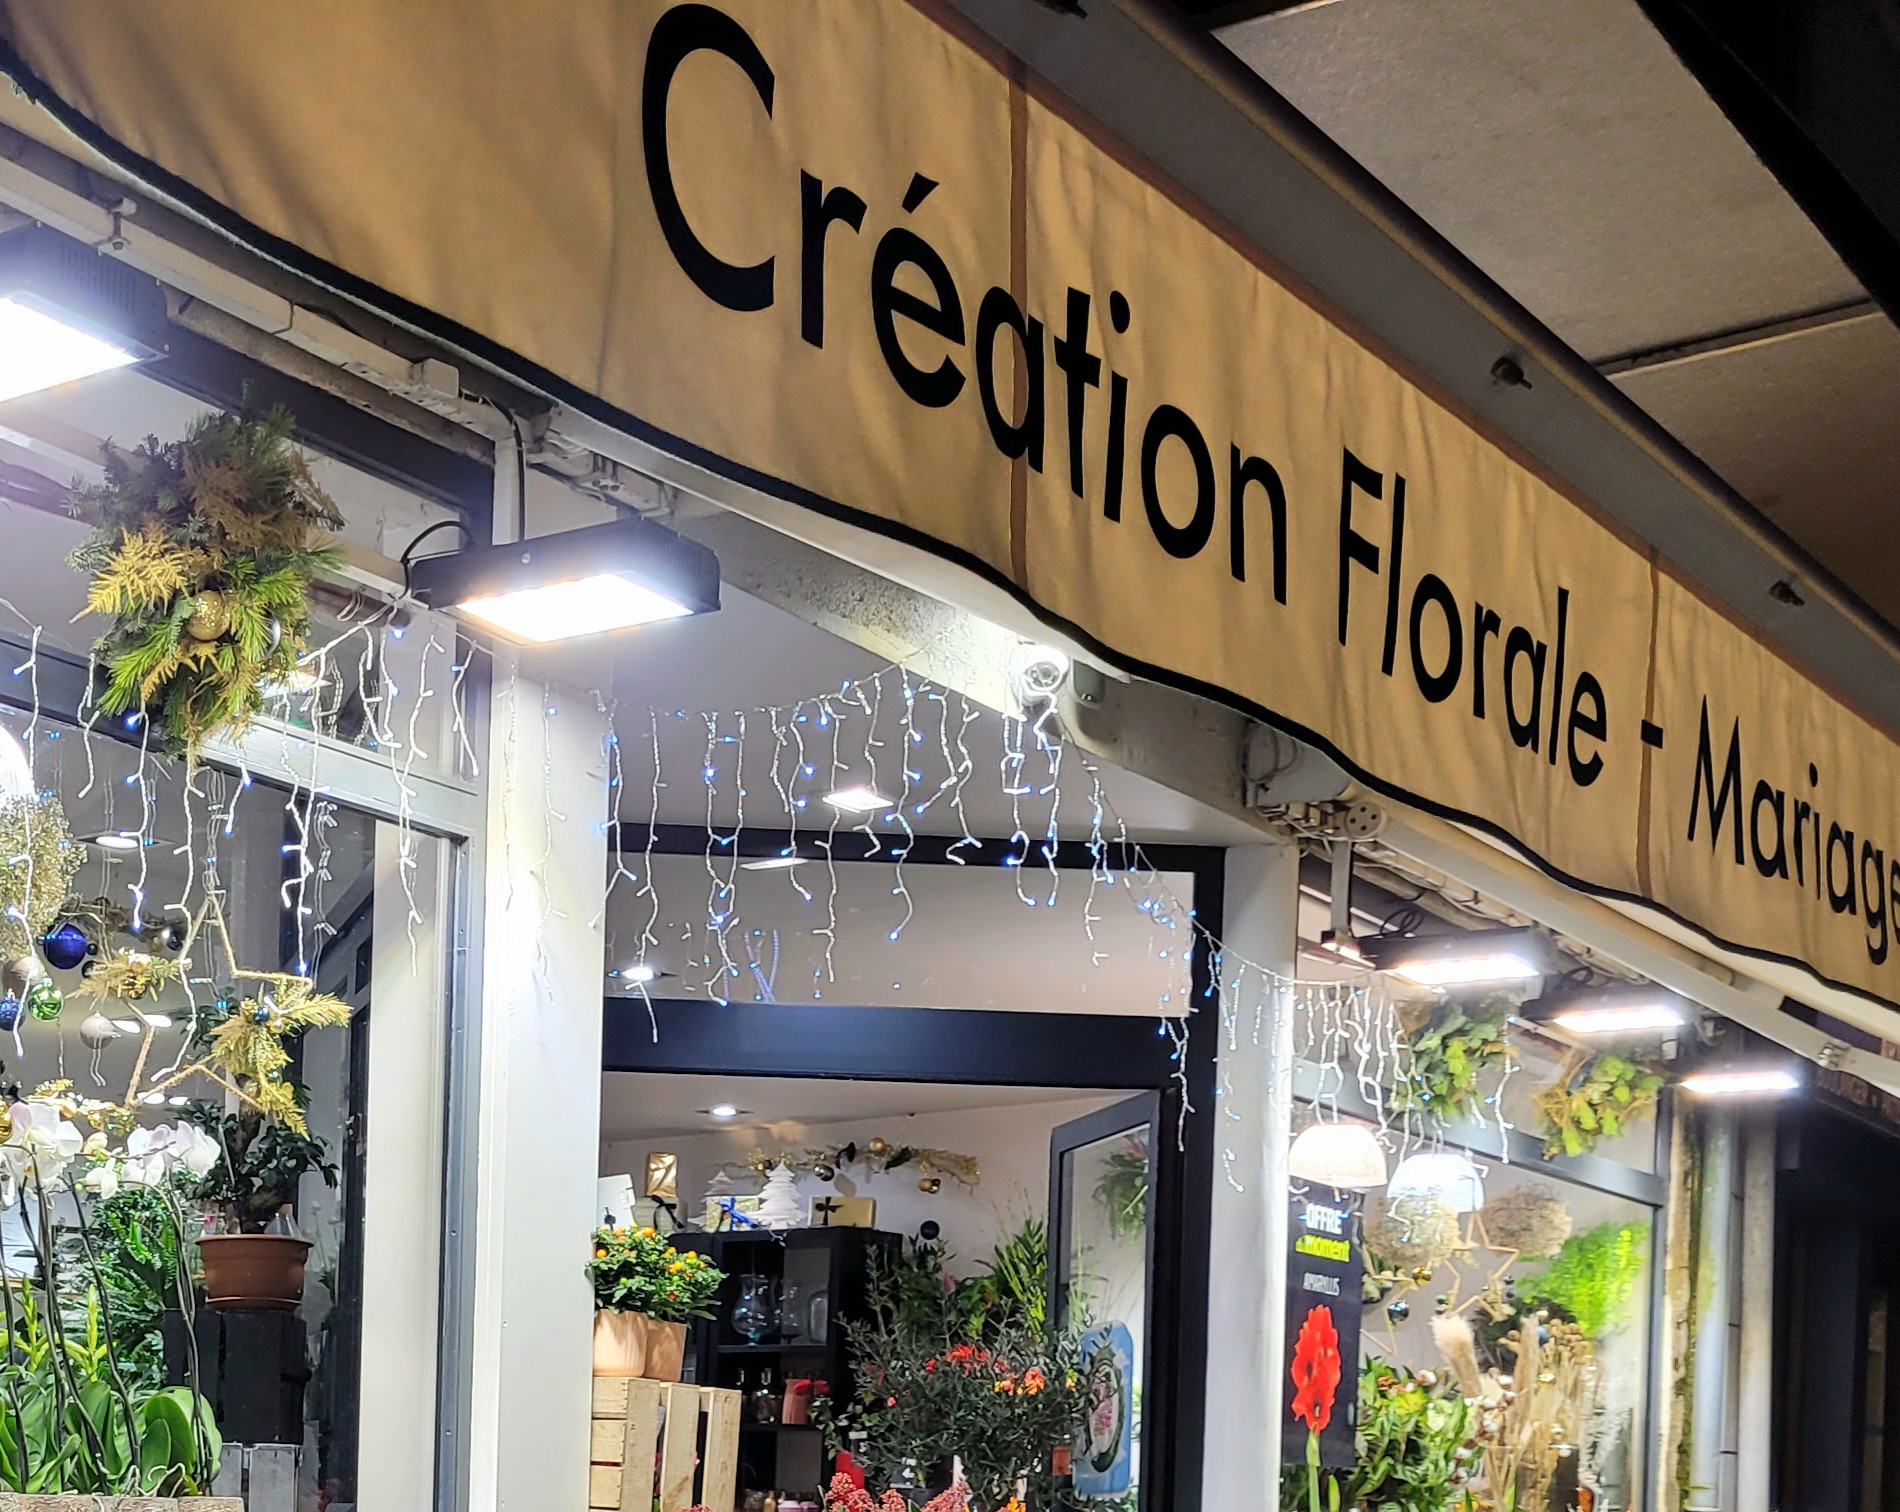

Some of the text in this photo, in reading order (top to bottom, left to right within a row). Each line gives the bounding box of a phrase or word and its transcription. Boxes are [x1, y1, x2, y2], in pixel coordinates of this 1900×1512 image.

[641, 3, 1288, 606] Création
[1337, 446, 1608, 787] Florale
[1305, 1202, 1343, 1235] OFFRE
